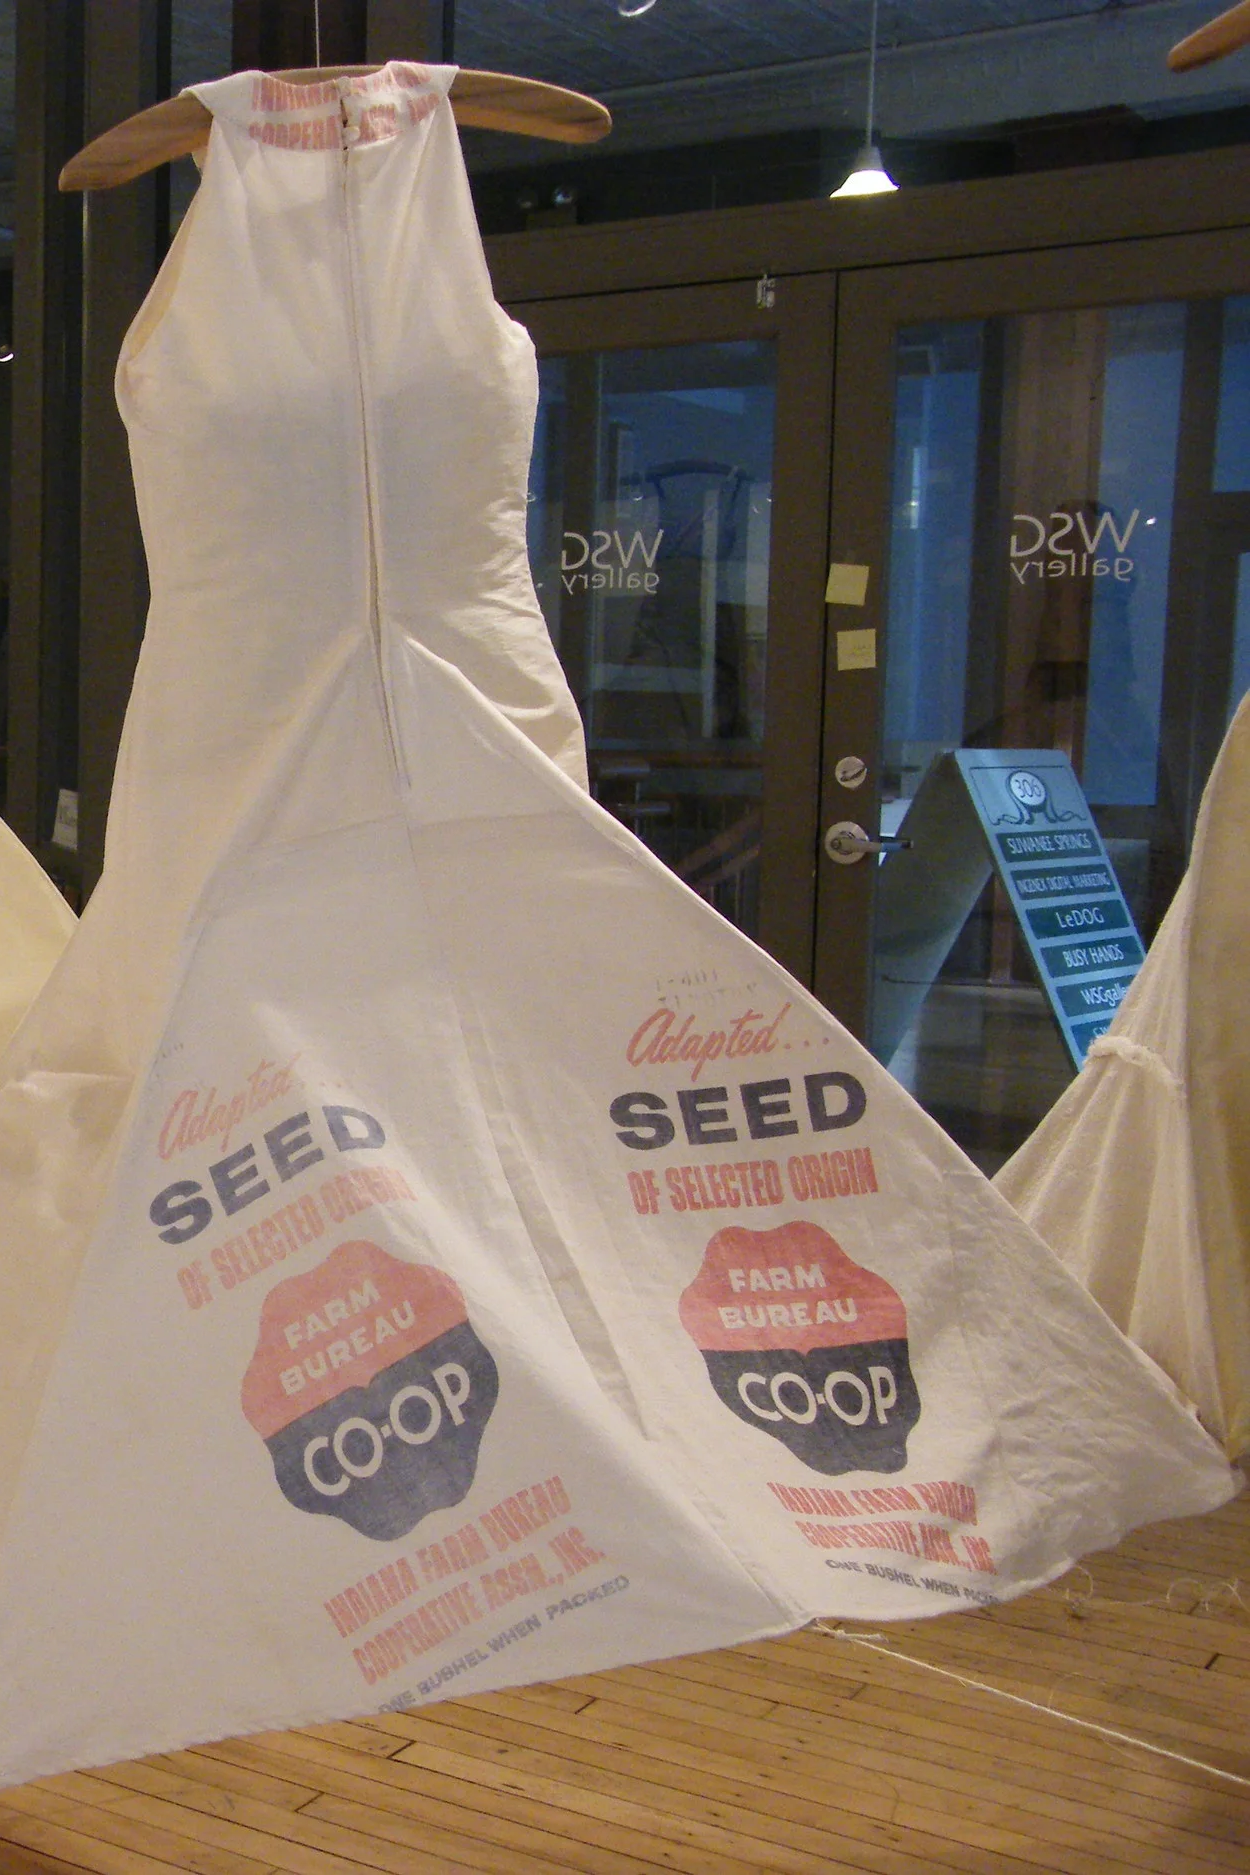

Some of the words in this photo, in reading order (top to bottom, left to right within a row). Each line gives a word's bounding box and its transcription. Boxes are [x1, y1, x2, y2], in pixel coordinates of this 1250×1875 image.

[1014, 778, 1042, 799] 306
[1054, 906, 1105, 929] LeDOG
[1062, 948, 1091, 969] BUSY
[1089, 943, 1125, 964] HANDS
[1079, 979, 1130, 1008] WSGgalle
[609, 1071, 867, 1151] SEED
[149, 1105, 386, 1245] SEED
[627, 1169, 660, 1215] OF
[664, 1159, 785, 1212] SELECTED
[787, 1147, 879, 1202] ORIGIN
[175, 1260, 213, 1311] OF
[210, 1194, 326, 1291] SELECTED
[728, 1263, 827, 1293] FARM
[282, 1278, 382, 1350] FARM
[718, 1298, 858, 1330] BUREAU
[278, 1301, 416, 1396] BUREAU
[303, 1362, 471, 1497] CO-OP
[737, 1366, 897, 1426] CO-OP
[766, 1481, 862, 1518] INDIANA
[850, 1486, 922, 1515] FARM
[323, 1556, 420, 1638] INDIANA
[414, 1523, 491, 1583] FARM
[478, 1475, 572, 1553] BUREAU
[824, 1558, 862, 1573] ONE
[866, 1563, 921, 1588] BUSHEL
[921, 1577, 961, 1598] WHEN
[352, 1581, 484, 1686] COOPERATIVE
[416, 1648, 489, 1696] BUSHEL
[486, 1614, 542, 1653] WHEN
[545, 1574, 630, 1621] PACKED
